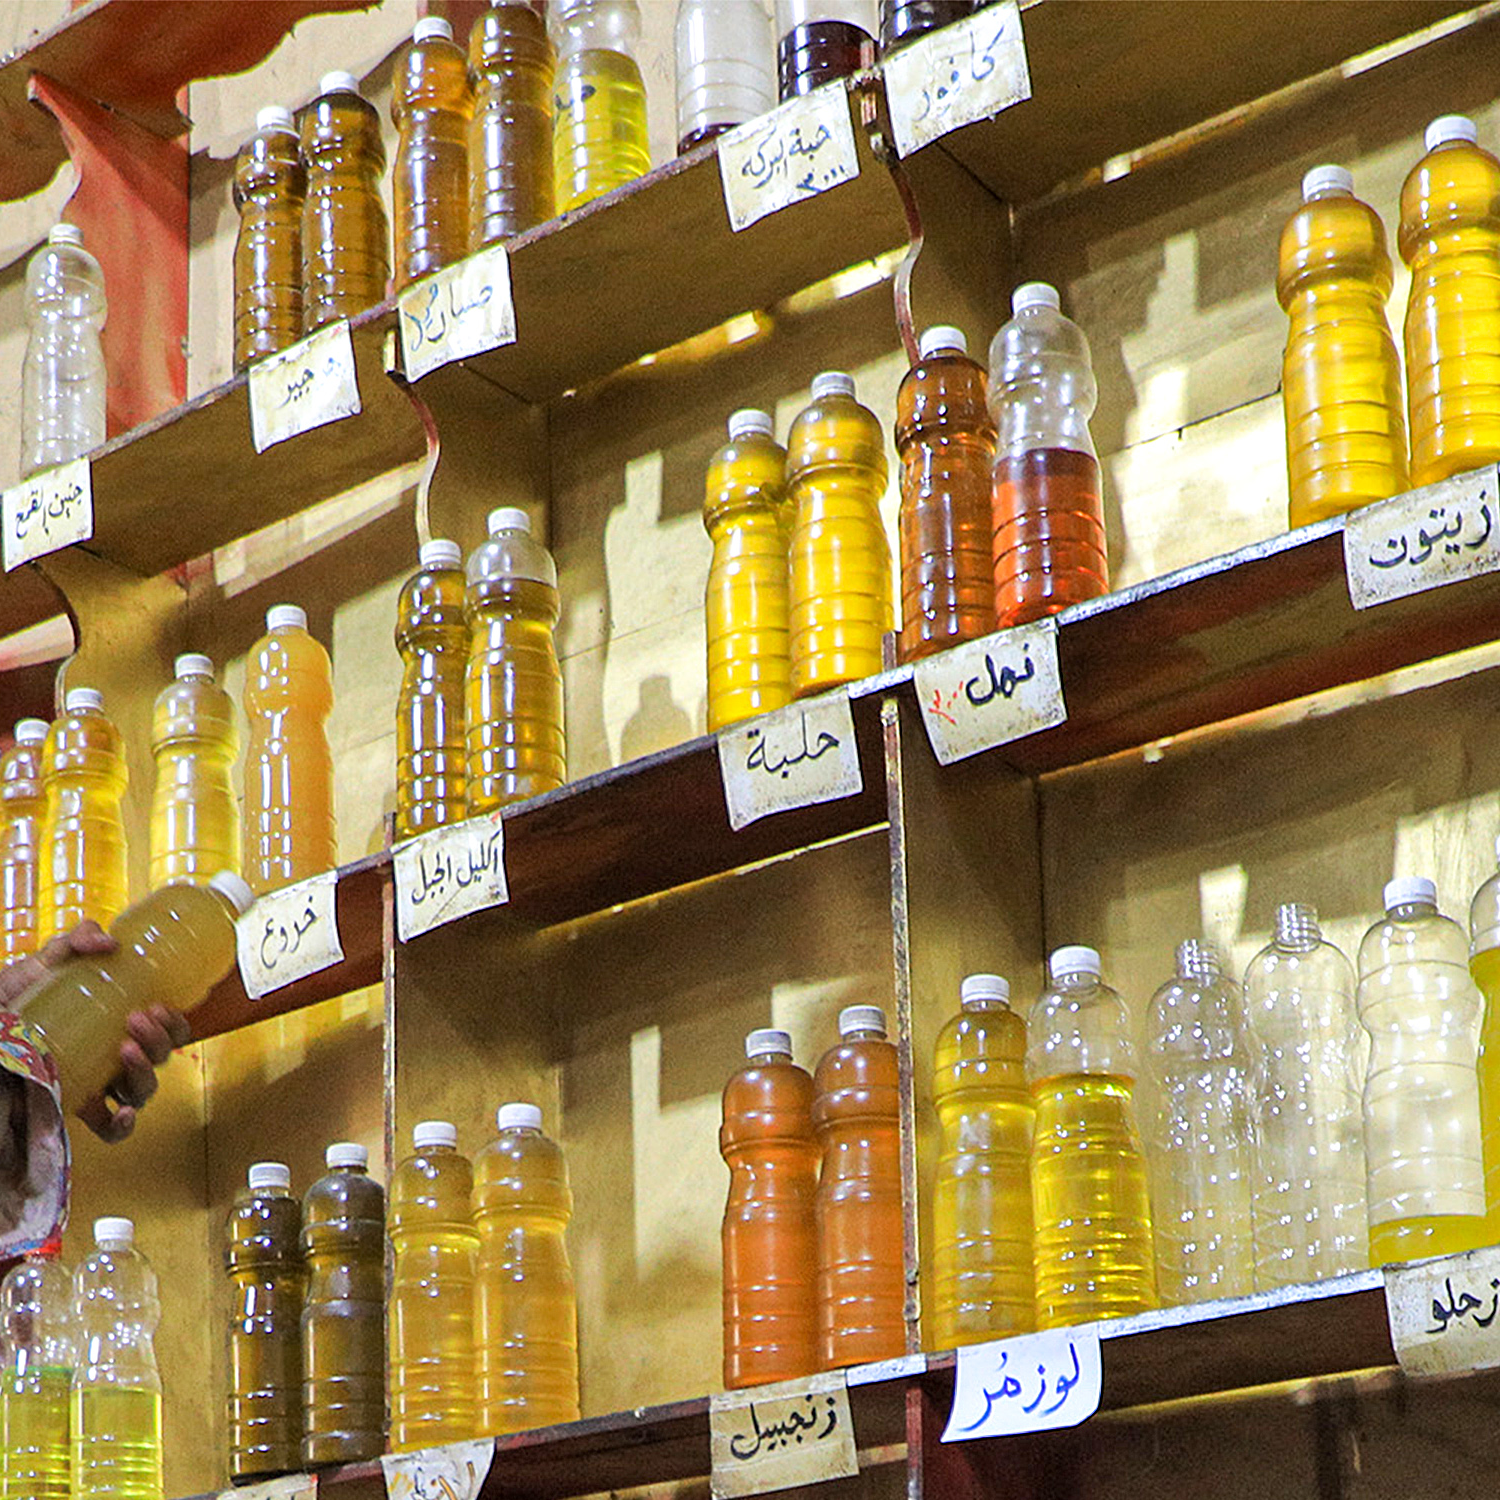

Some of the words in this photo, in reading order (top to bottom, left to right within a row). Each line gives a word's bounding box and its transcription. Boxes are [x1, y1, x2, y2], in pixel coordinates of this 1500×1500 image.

[912, 24, 1004, 122] كافور
[1369, 489, 1492, 569] زيتون
[746, 710, 840, 779] حلبة
[260, 895, 318, 969] خروع
[1425, 1277, 1482, 1334] حلو
[1022, 1342, 1080, 1418] لوز
[729, 1393, 838, 1460] زنجبيل
